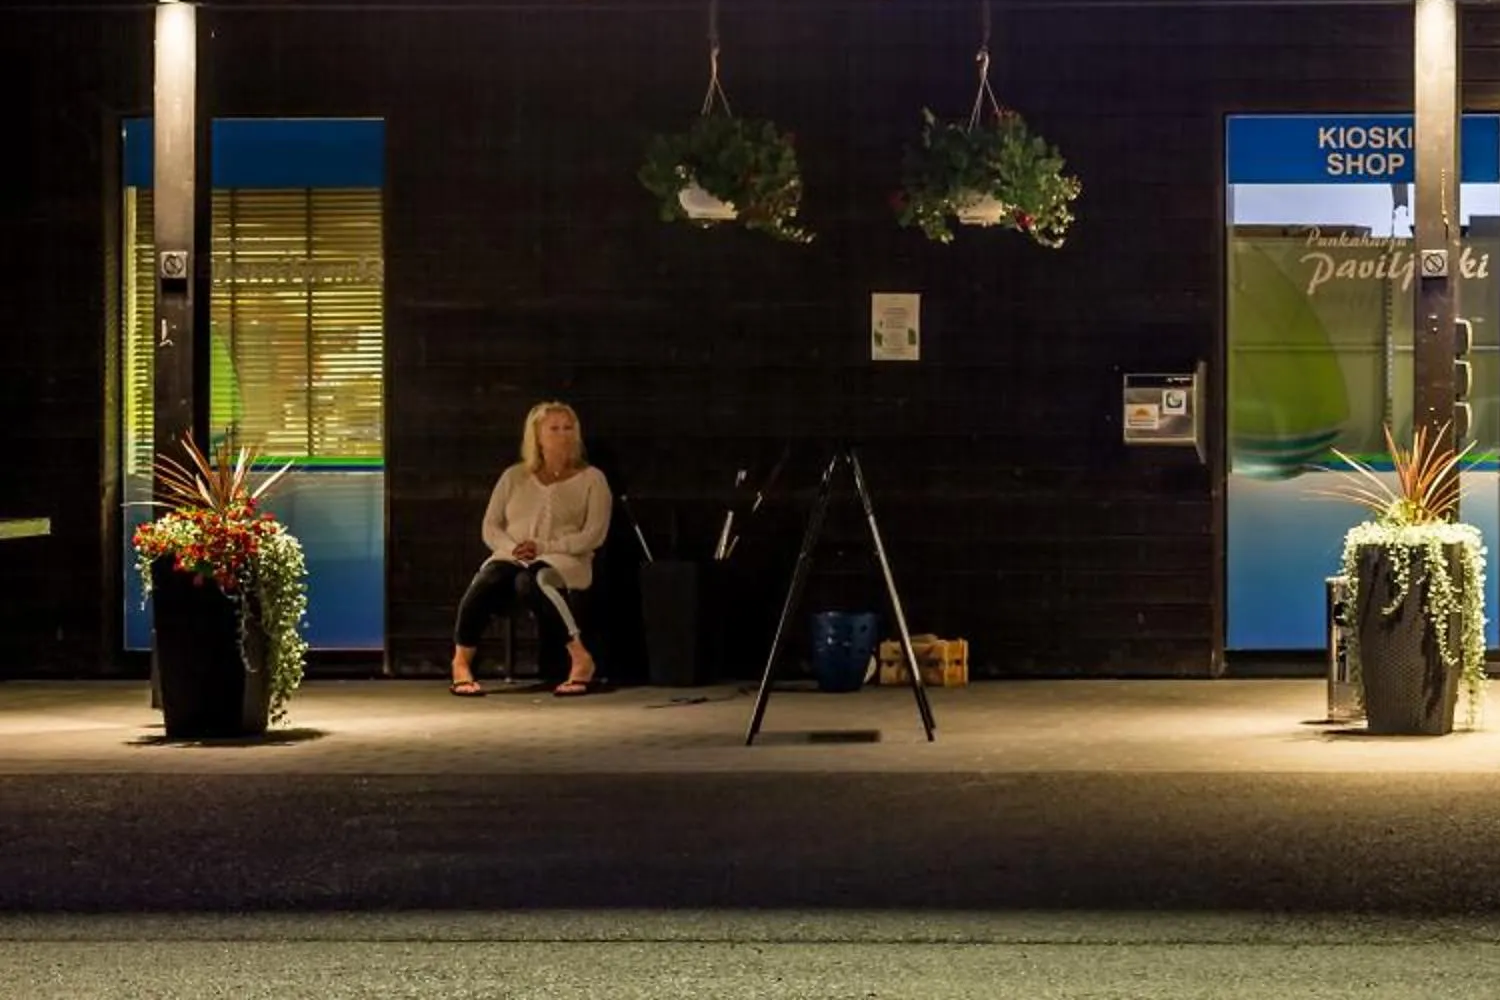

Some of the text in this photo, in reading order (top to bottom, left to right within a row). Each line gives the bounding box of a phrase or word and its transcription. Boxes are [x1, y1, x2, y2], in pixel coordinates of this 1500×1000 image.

[1318, 126, 1413, 149] KIOSKI
[1326, 153, 1406, 175] SHOP
[1299, 247, 1489, 296] Paviljki
